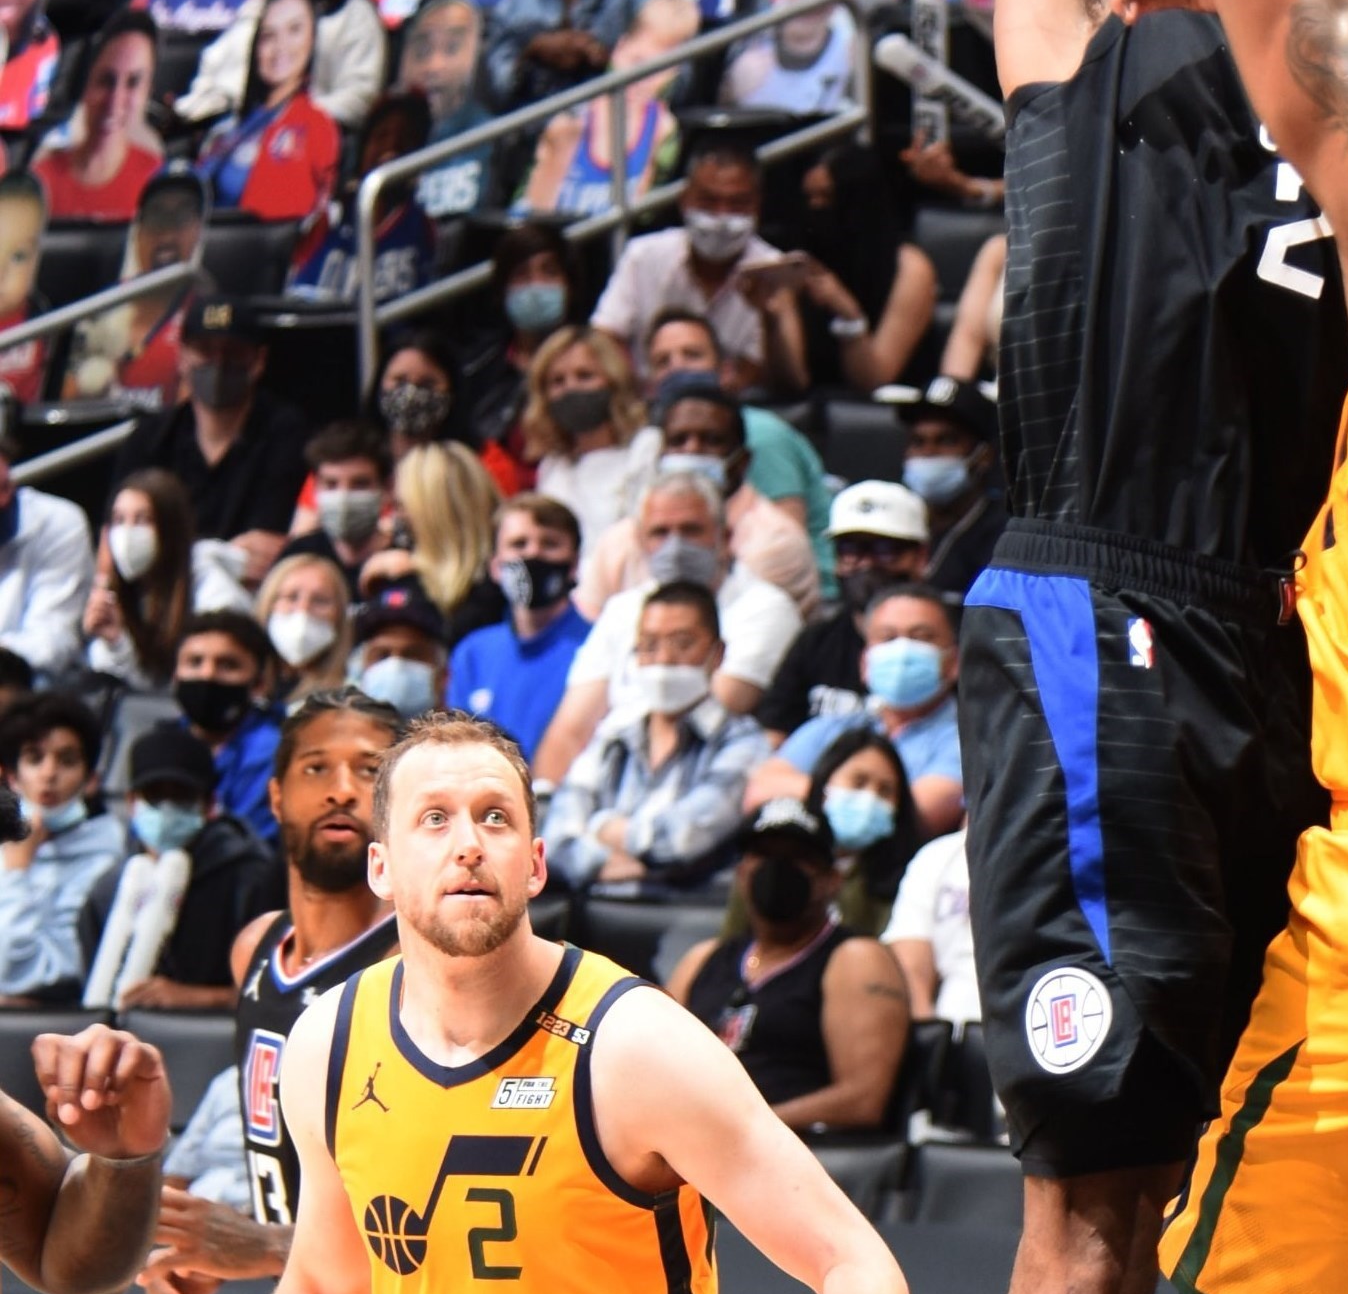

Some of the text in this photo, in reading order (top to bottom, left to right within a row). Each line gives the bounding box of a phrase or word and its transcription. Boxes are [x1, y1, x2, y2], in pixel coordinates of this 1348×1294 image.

[498, 1081, 516, 1105] 5
[516, 1094, 550, 1105] FIGHT
[466, 1187, 523, 1281] 2
